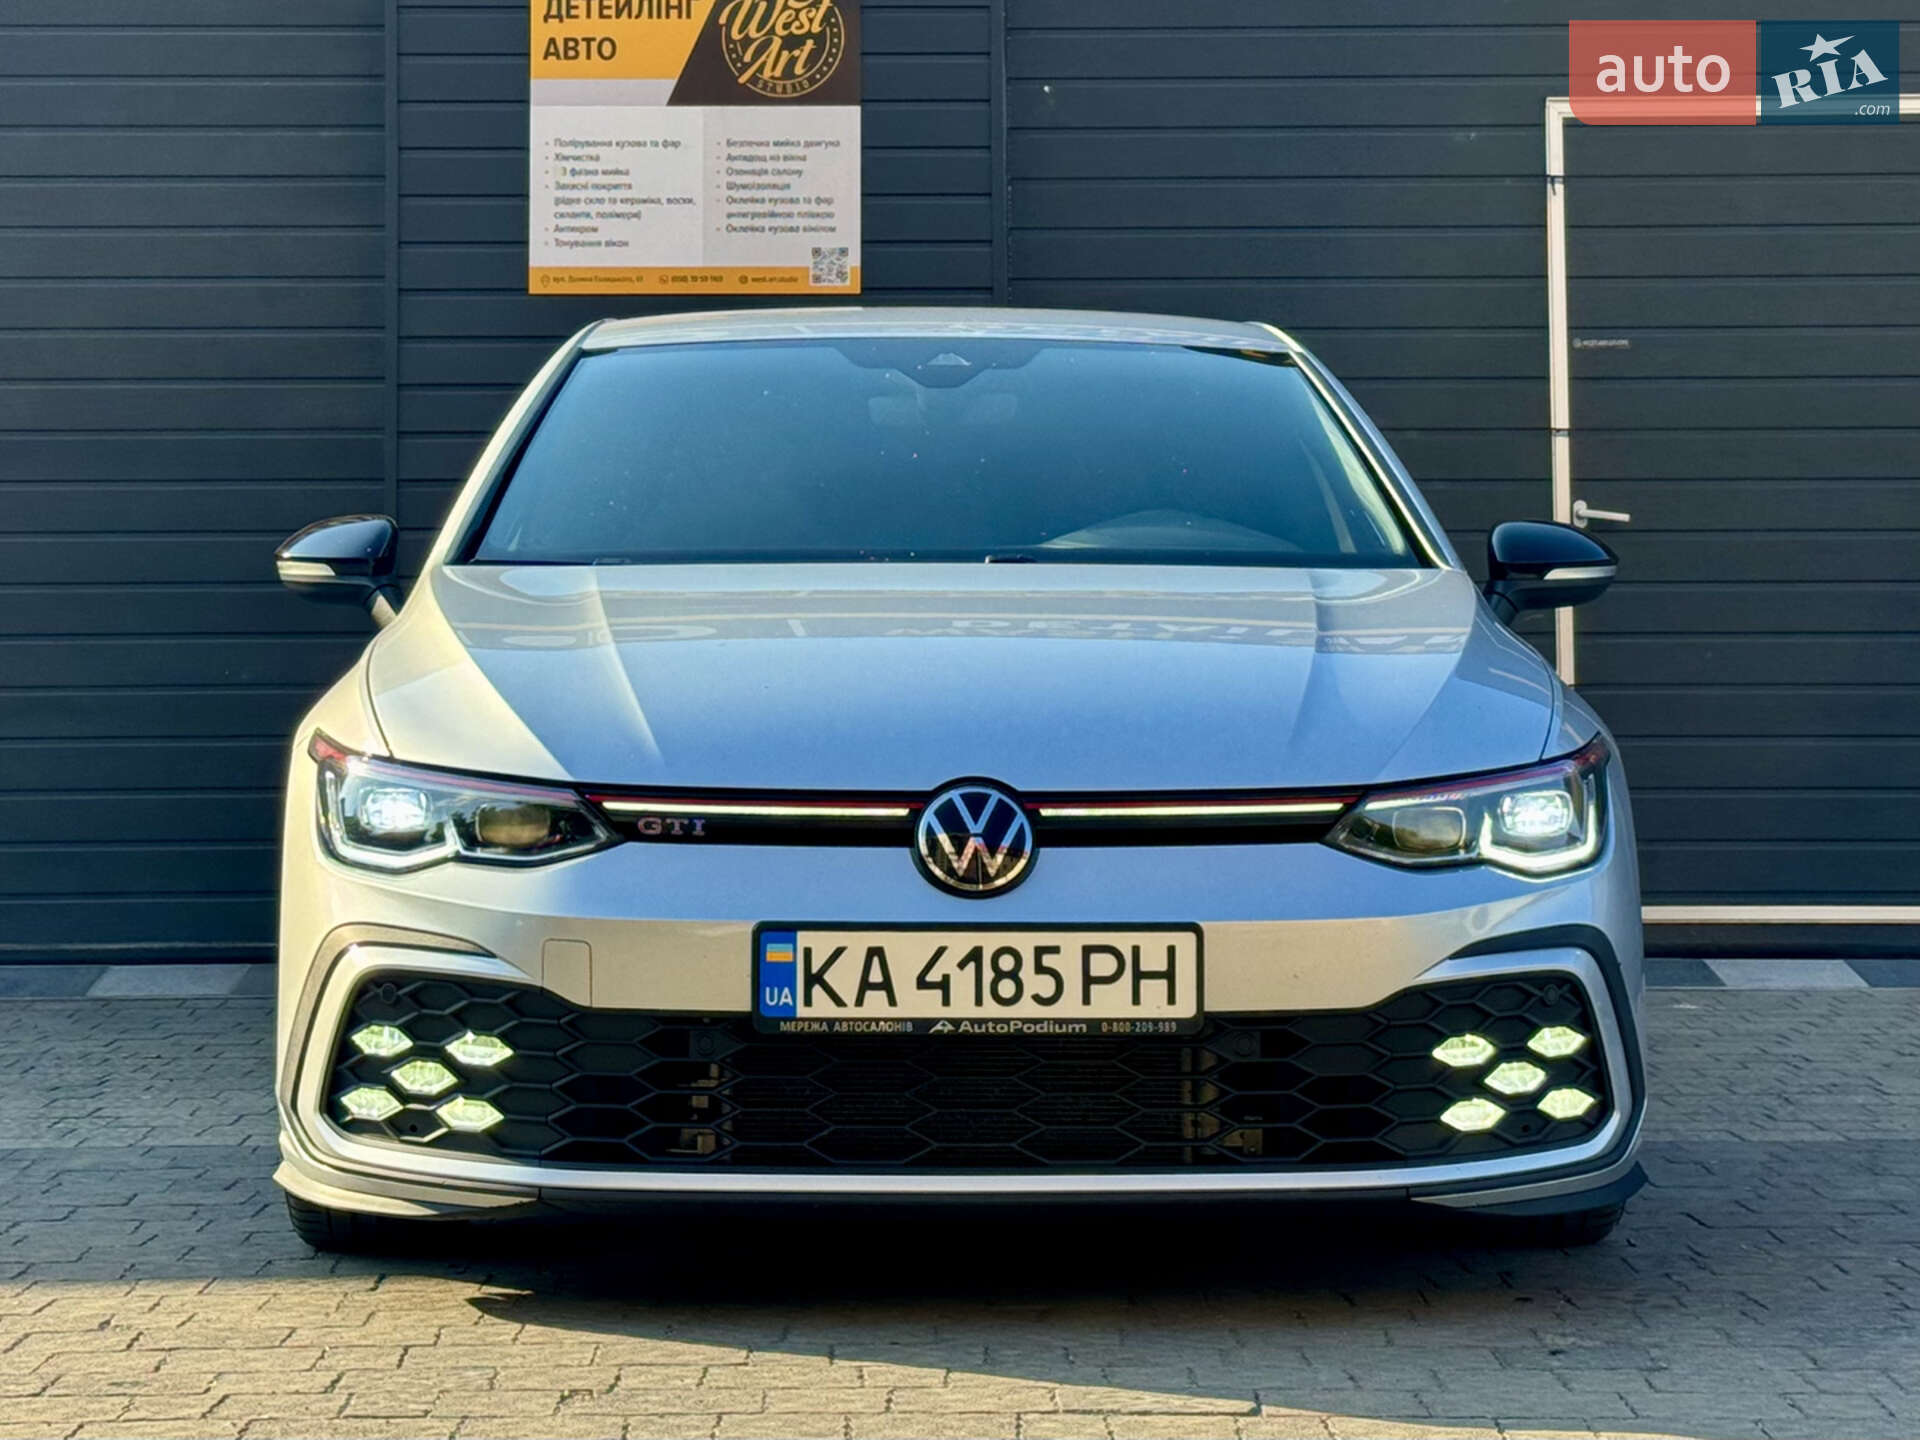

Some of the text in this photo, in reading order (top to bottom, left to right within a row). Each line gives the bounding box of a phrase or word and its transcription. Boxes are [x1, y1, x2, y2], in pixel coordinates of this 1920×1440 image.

[719, 0, 833, 40] West
[543, 37, 617, 61] АВТО
[738, 35, 816, 84] Art
[637, 817, 707, 837] GTI
[802, 945, 1177, 1007] KA 4185 PH
[765, 986, 793, 1006] UA
[780, 1021, 913, 1032] МЕРЕЖА АВТОСАЛОНІВ
[958, 1020, 1087, 1033] AutoPodium
